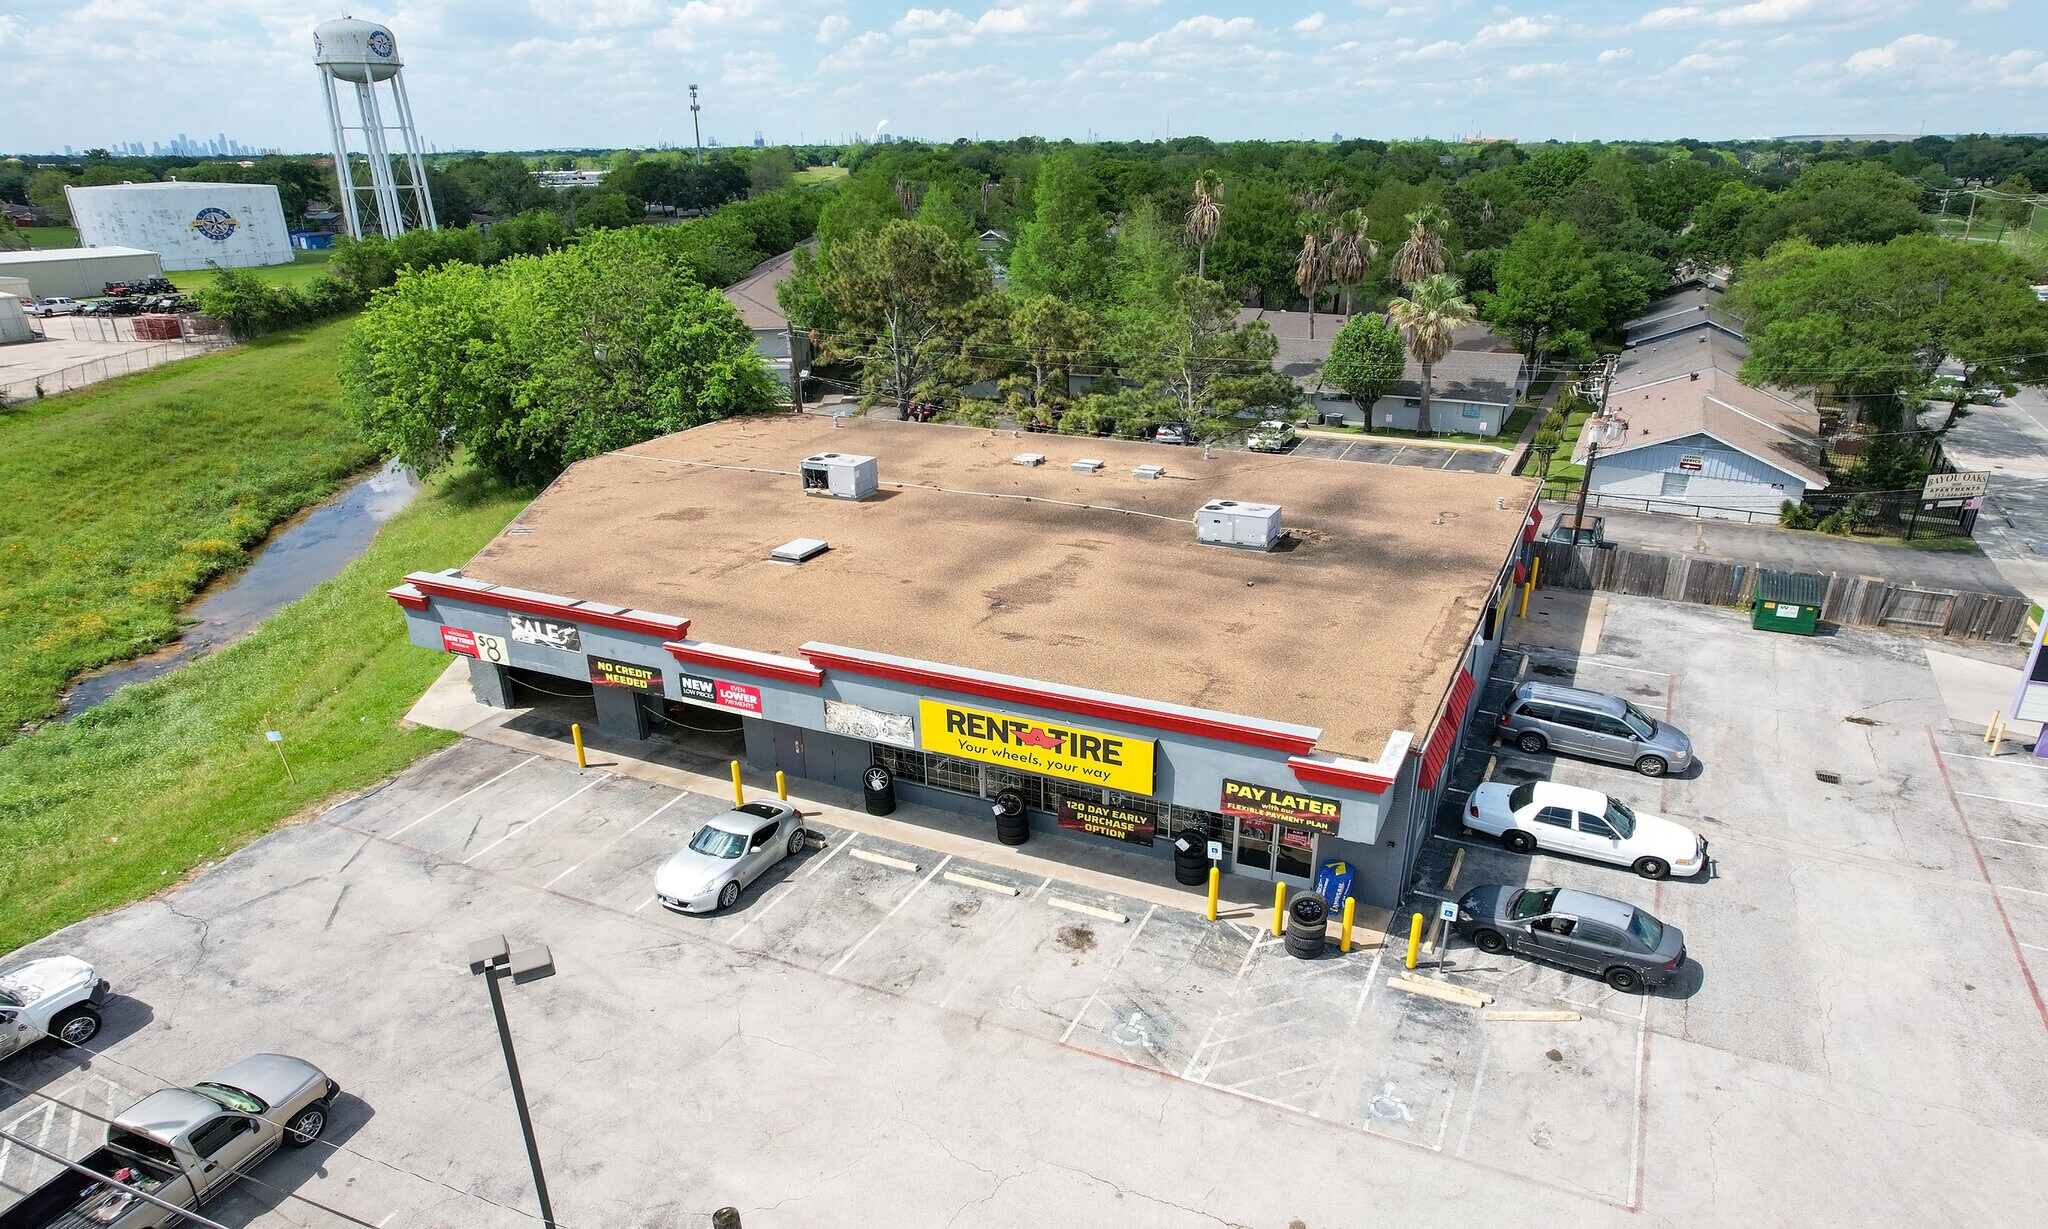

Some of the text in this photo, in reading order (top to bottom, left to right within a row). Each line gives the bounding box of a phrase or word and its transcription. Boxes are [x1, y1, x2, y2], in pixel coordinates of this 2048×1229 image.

[1927, 473, 1986, 487] BAYOU OAKS
[511, 617, 559, 639] SALE
[597, 661, 653, 680] NO CREDIT
[605, 673, 648, 689] NEEDED
[681, 677, 713, 693] NEW
[683, 688, 715, 700] LOW PRICES
[720, 688, 758, 705] LOWER
[730, 685, 746, 694] EVEN
[725, 698, 755, 710] PAYMENTS
[958, 738, 1112, 782] Your wheels, your way
[1226, 782, 1337, 817] PAY LATER
[1261, 803, 1280, 812] with
[1066, 800, 1148, 825] 120 DAY EARLY
[1227, 802, 1264, 816] FLEXIBLE
[1264, 811, 1305, 824] PAYMENT
[1305, 819, 1328, 830] PLAN
[1077, 812, 1135, 832] PURCHASE
[1085, 823, 1126, 839] OPTION
